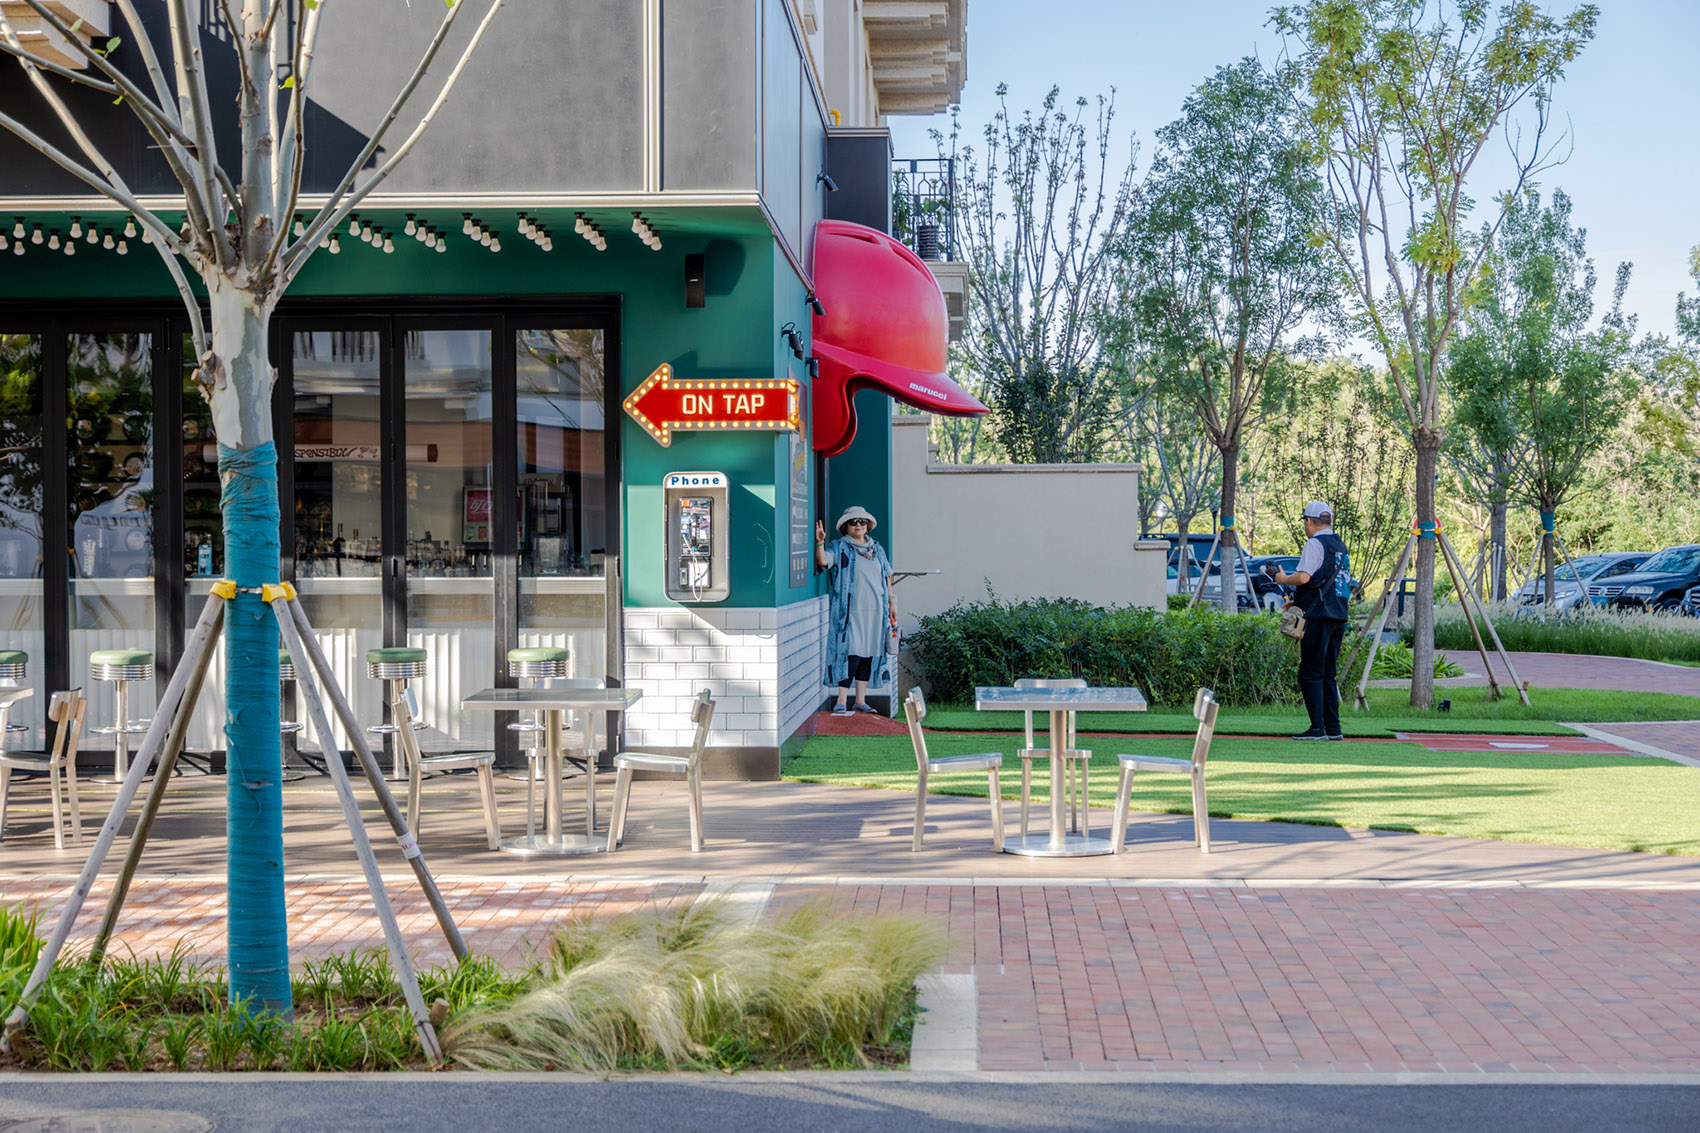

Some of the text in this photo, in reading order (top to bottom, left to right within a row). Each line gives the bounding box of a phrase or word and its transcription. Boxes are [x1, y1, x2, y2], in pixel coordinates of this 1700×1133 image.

[909, 382, 947, 401] marucci
[682, 394, 765, 415] ON TAP
[671, 476, 720, 486] Phone
